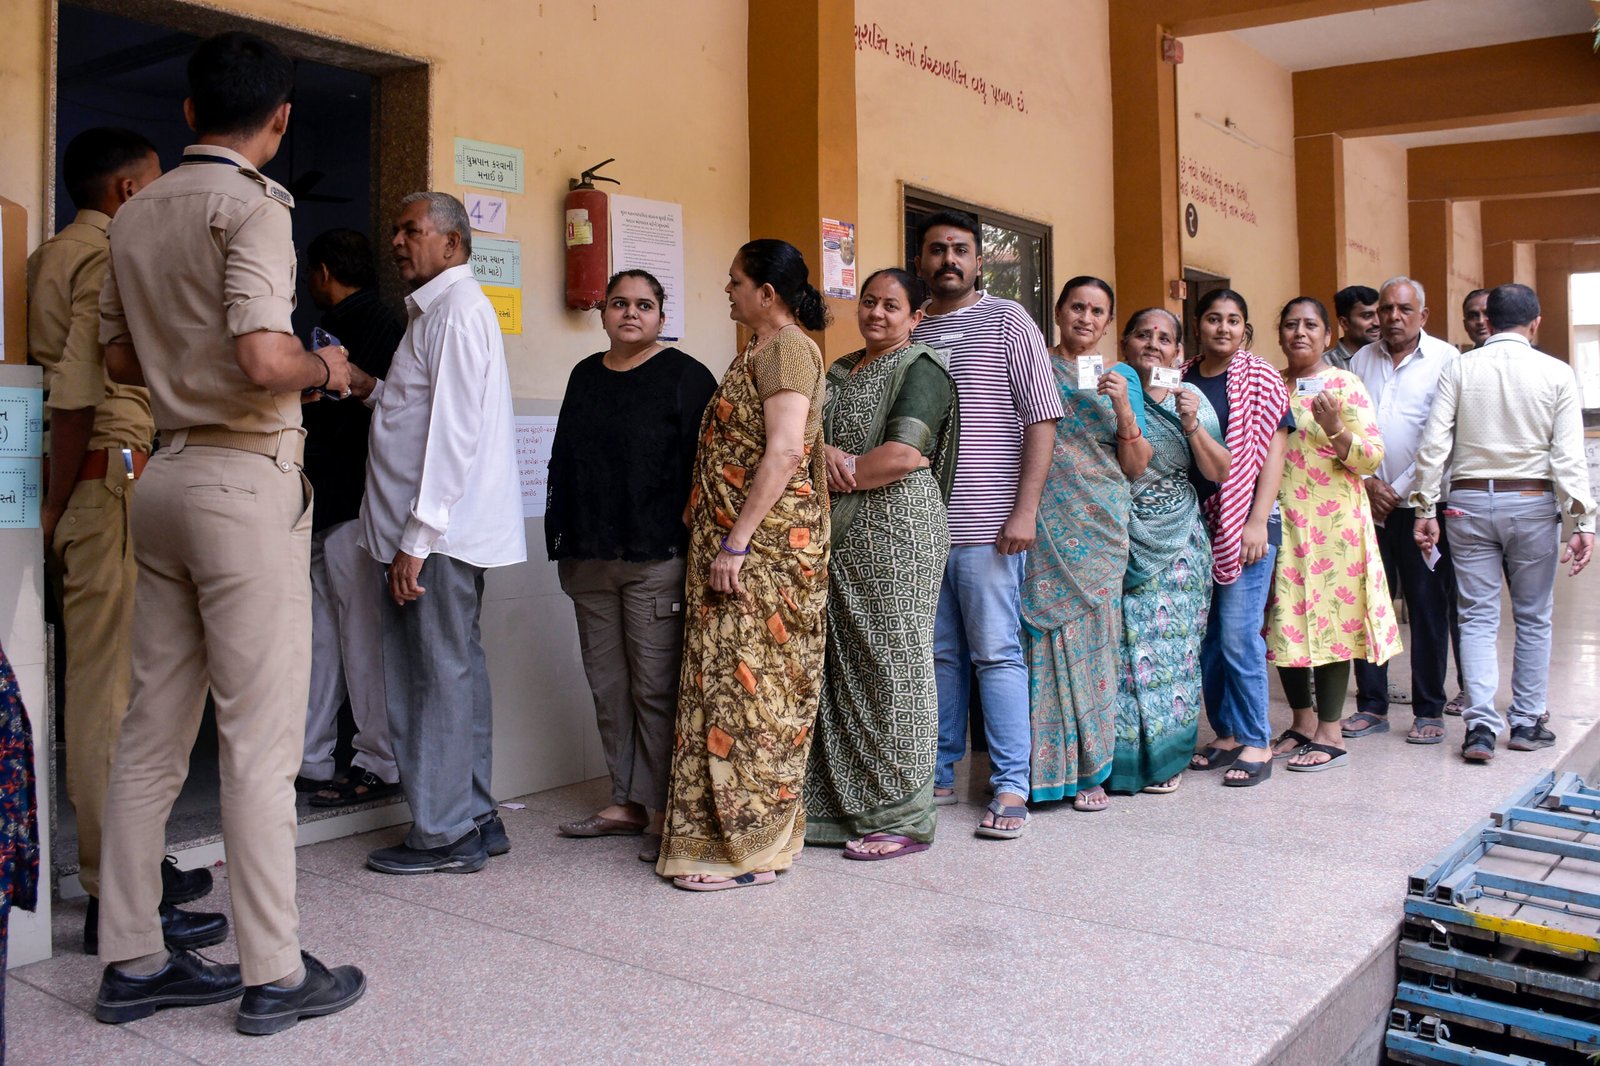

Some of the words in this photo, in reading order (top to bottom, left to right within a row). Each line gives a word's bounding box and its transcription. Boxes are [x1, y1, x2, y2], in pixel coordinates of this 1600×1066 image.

[855, 23, 890, 55] ણુશક્તિ
[971, 77, 987, 105] વધુ
[491, 160, 514, 172] કરવાની
[477, 170, 496, 182] મનાઈ
[497, 171, 505, 183] છે
[469, 200, 503, 225] 47
[489, 255, 505, 265] સ્થાન
[488, 266, 503, 278] માટે)
